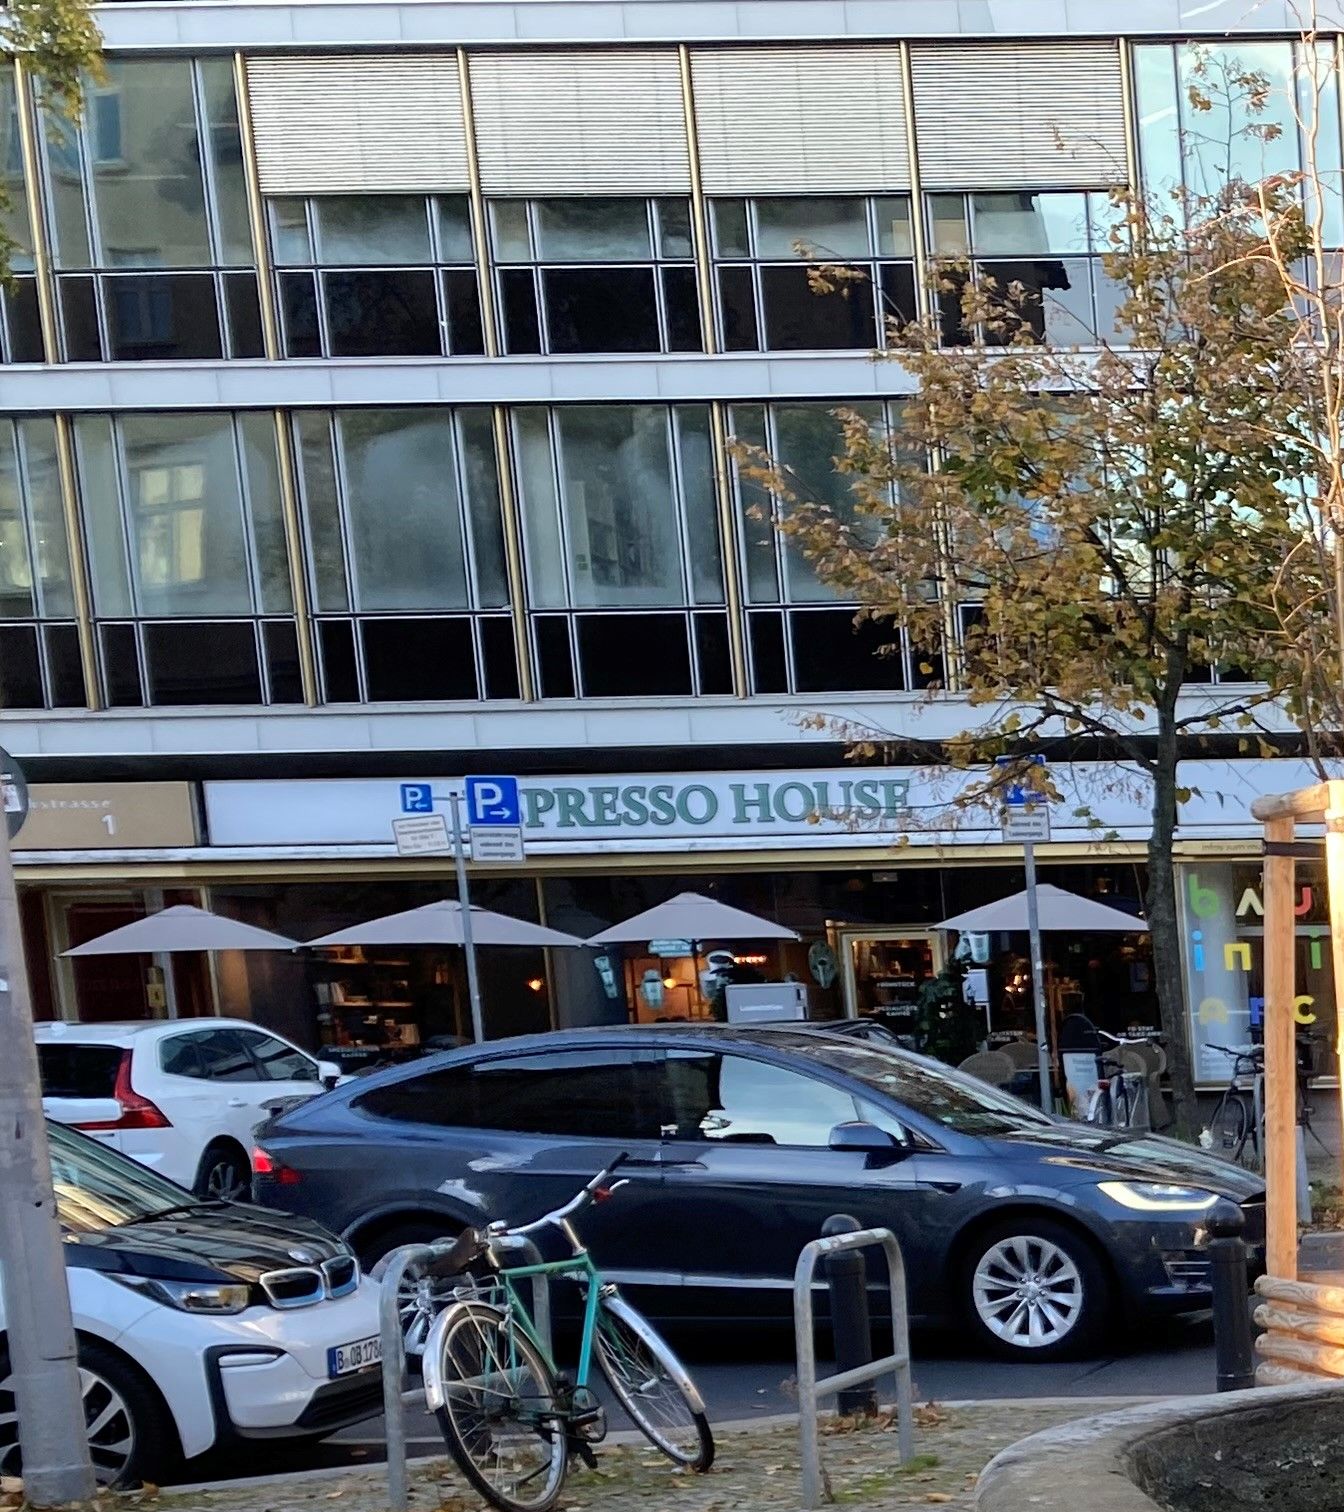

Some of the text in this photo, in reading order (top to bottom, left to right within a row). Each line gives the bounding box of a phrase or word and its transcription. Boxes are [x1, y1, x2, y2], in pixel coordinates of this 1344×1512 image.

[405, 787, 422, 809] P
[473, 782, 502, 819] P
[522, 779, 912, 828] PRESSO HOUSE
[102, 815, 114, 834] 1
